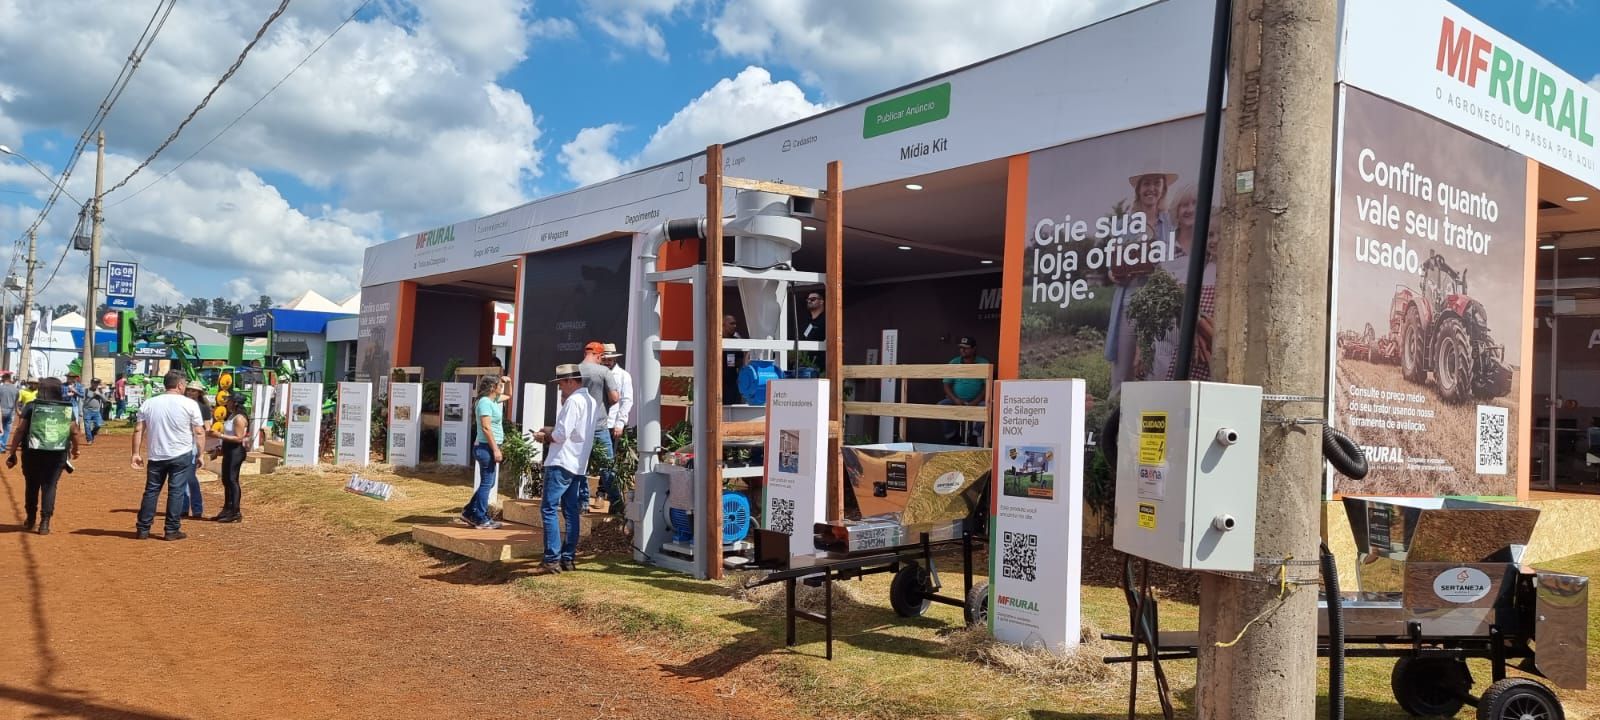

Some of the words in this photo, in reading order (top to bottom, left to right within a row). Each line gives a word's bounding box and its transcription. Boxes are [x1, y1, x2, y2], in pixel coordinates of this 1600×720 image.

[1436, 16, 1594, 147] MFRURAL
[876, 109, 905, 124] Publicar
[905, 101, 935, 116] Anúncio
[1435, 87, 1442, 99] O
[1447, 93, 1521, 136] AGRONEGÓCIO
[1525, 129, 1553, 152] PASSA
[1557, 144, 1573, 160] POR
[1577, 153, 1595, 171] AQUI
[792, 135, 818, 148] Cadastro
[900, 142, 929, 160] Mídia
[932, 137, 948, 153] Kit
[1358, 148, 1433, 201] Confira
[1437, 182, 1498, 223] quanto
[625, 209, 660, 225] Depoimentos
[1034, 214, 1087, 246] Crie
[1095, 211, 1146, 239] sua
[1356, 194, 1400, 230] vale
[1405, 210, 1438, 241] seu
[1443, 216, 1491, 255] trator
[416, 224, 455, 249] MFRURAL
[1034, 245, 1078, 280] loja
[1086, 232, 1176, 270] oficial
[1355, 236, 1424, 276] usado.
[1032, 273, 1095, 309] hoje.
[1003, 395, 1049, 404] Ensacadora
[1350, 385, 1380, 398] Consulte
[1380, 391, 1386, 399] o
[1386, 391, 1405, 403] preço
[1003, 406, 1013, 415] de
[1014, 405, 1046, 417] Silagem
[1349, 400, 1358, 410] do
[1360, 402, 1372, 412] seu
[1373, 403, 1391, 413] trator
[1392, 406, 1416, 416] usando
[1416, 408, 1435, 418] nossa
[1002, 427, 1023, 436] INOX
[1003, 416, 1039, 427] Sertaneja
[1349, 415, 1386, 429] ferramenta
[997, 595, 1040, 612] MFRURAL
